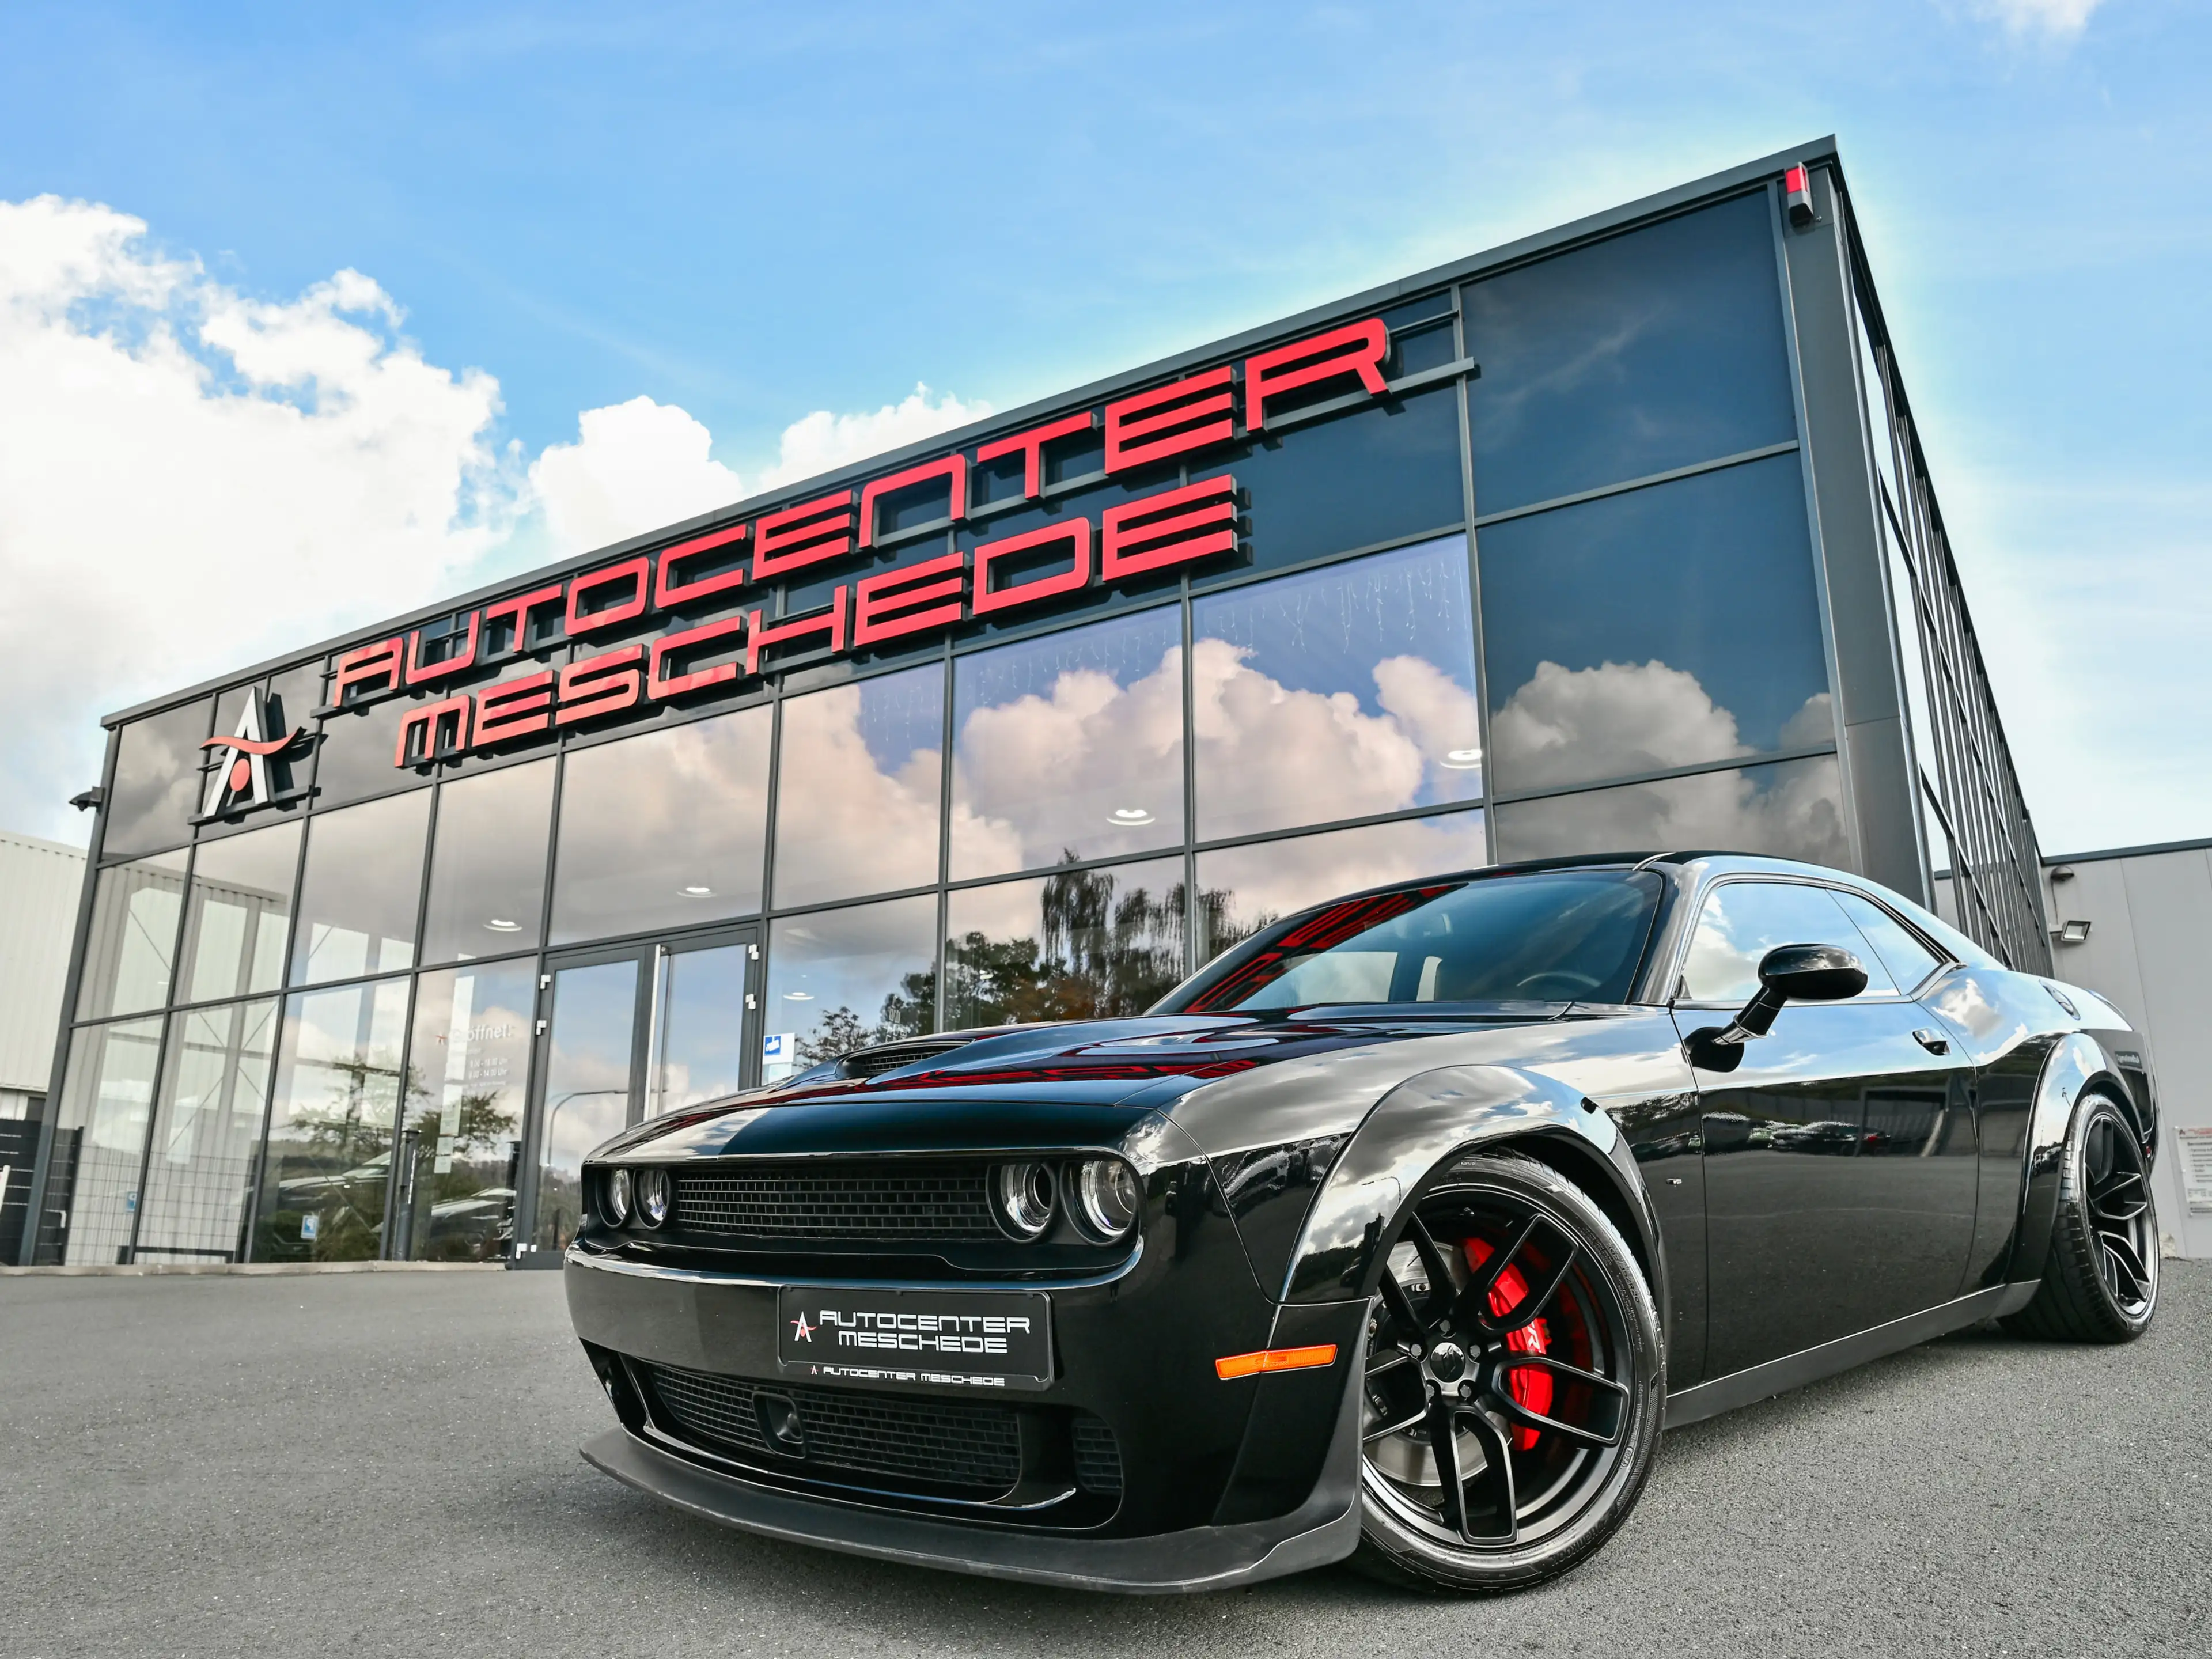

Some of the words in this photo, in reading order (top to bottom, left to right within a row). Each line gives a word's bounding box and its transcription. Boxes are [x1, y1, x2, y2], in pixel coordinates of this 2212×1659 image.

[333, 317, 1389, 708] AUTOCENTER
[395, 474, 1235, 769] MESCHEDE
[820, 1310, 1031, 1334] AUTOCENTER
[839, 1330, 1008, 1354] MESCHEDE
[823, 1366, 916, 1381] AUTOCENTER
[921, 1373, 1005, 1387] MESCHEDE
